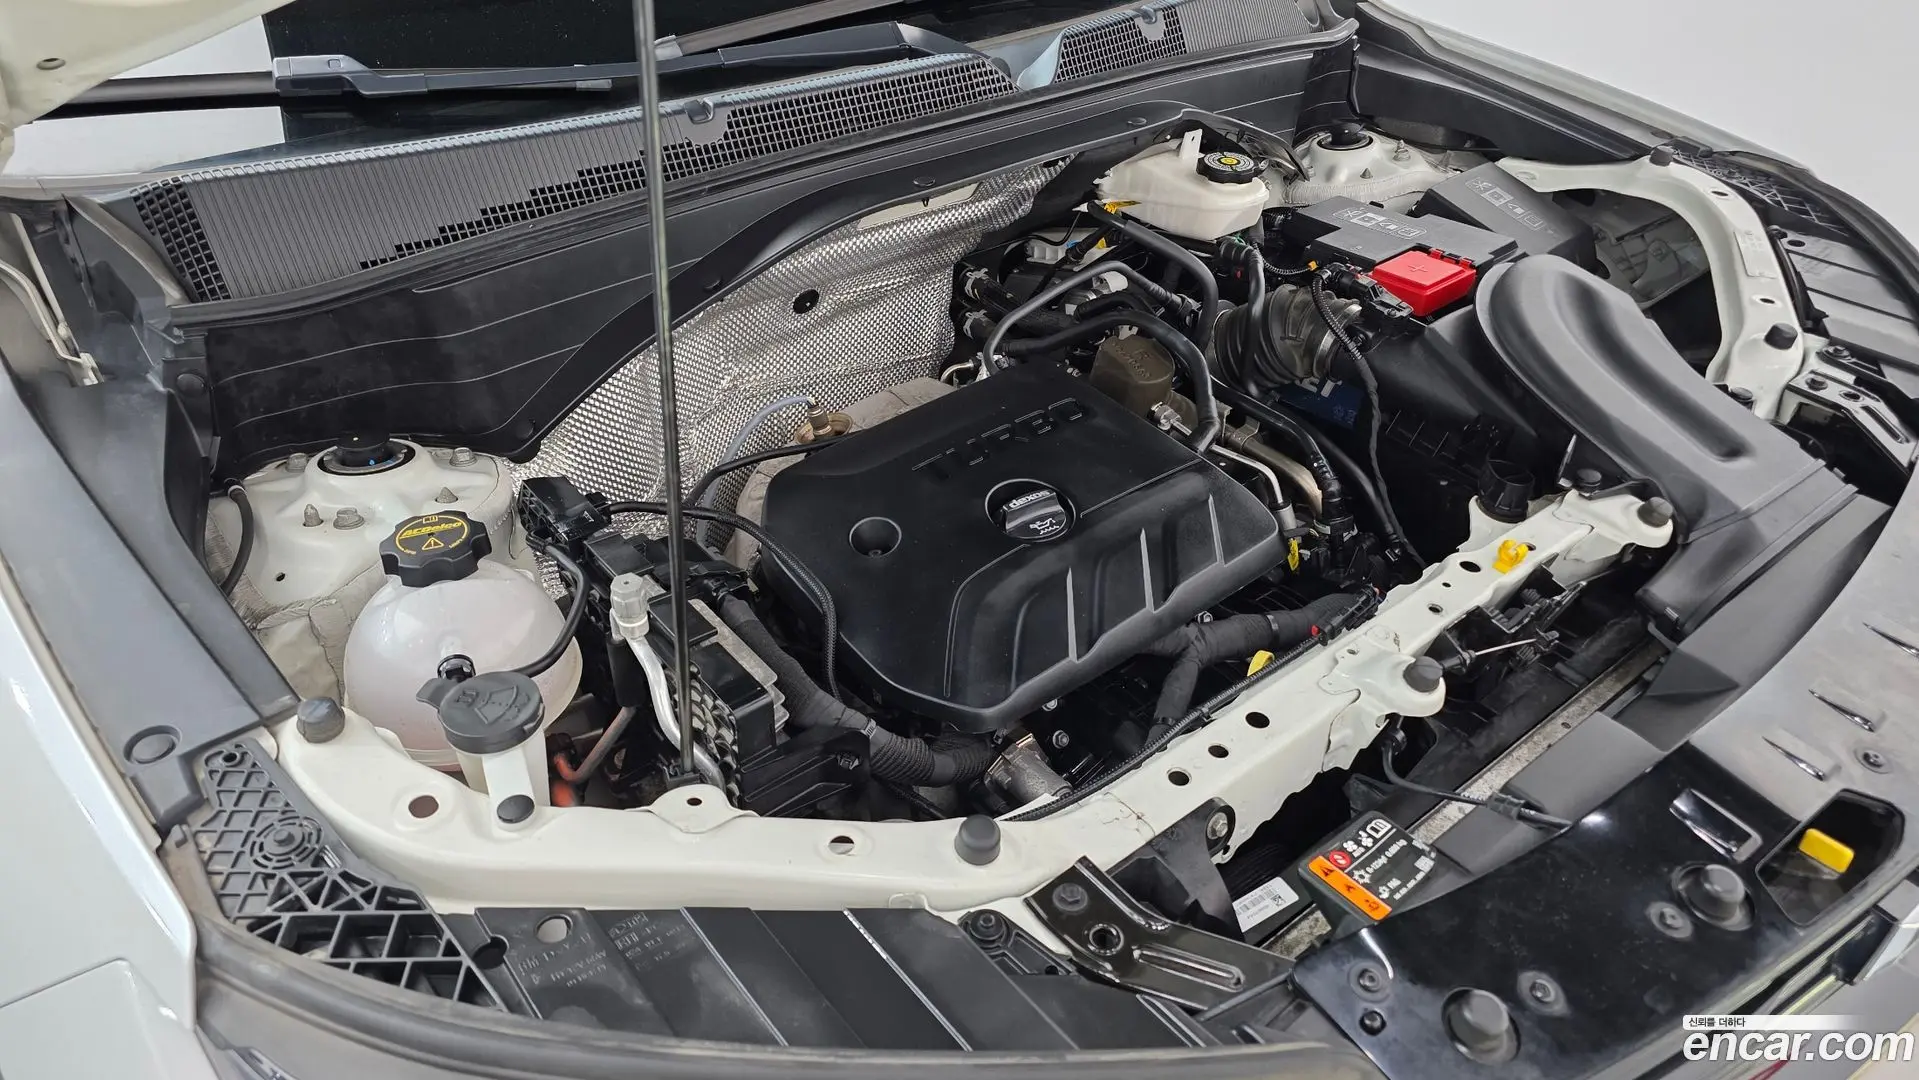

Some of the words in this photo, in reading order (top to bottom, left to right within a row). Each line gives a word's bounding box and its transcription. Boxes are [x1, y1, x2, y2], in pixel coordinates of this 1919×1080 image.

[911, 397, 1084, 479] TURBO
[1008, 490, 1052, 509] dexos
[400, 521, 463, 538] ACDelco
